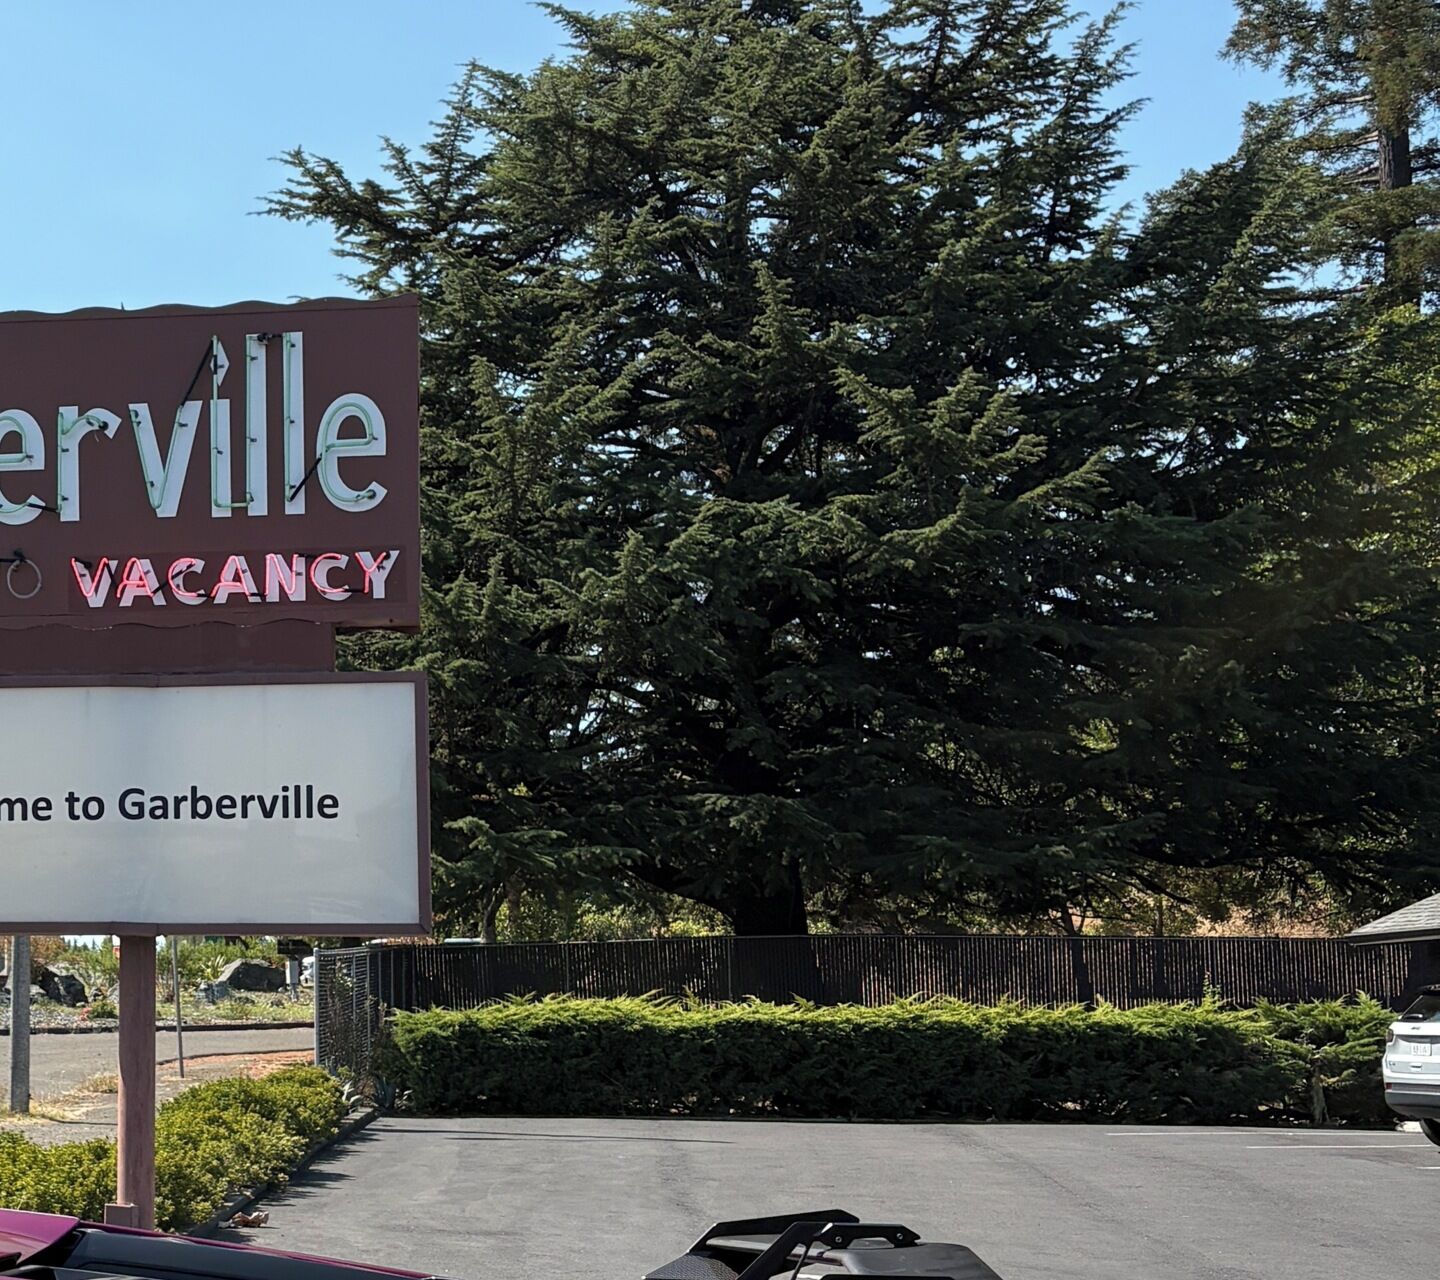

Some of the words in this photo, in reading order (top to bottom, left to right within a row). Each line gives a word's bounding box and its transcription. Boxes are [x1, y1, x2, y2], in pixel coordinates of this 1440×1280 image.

[71, 549, 401, 608] VACANCY
[65, 791, 105, 822] to
[118, 785, 340, 821] Garberville
